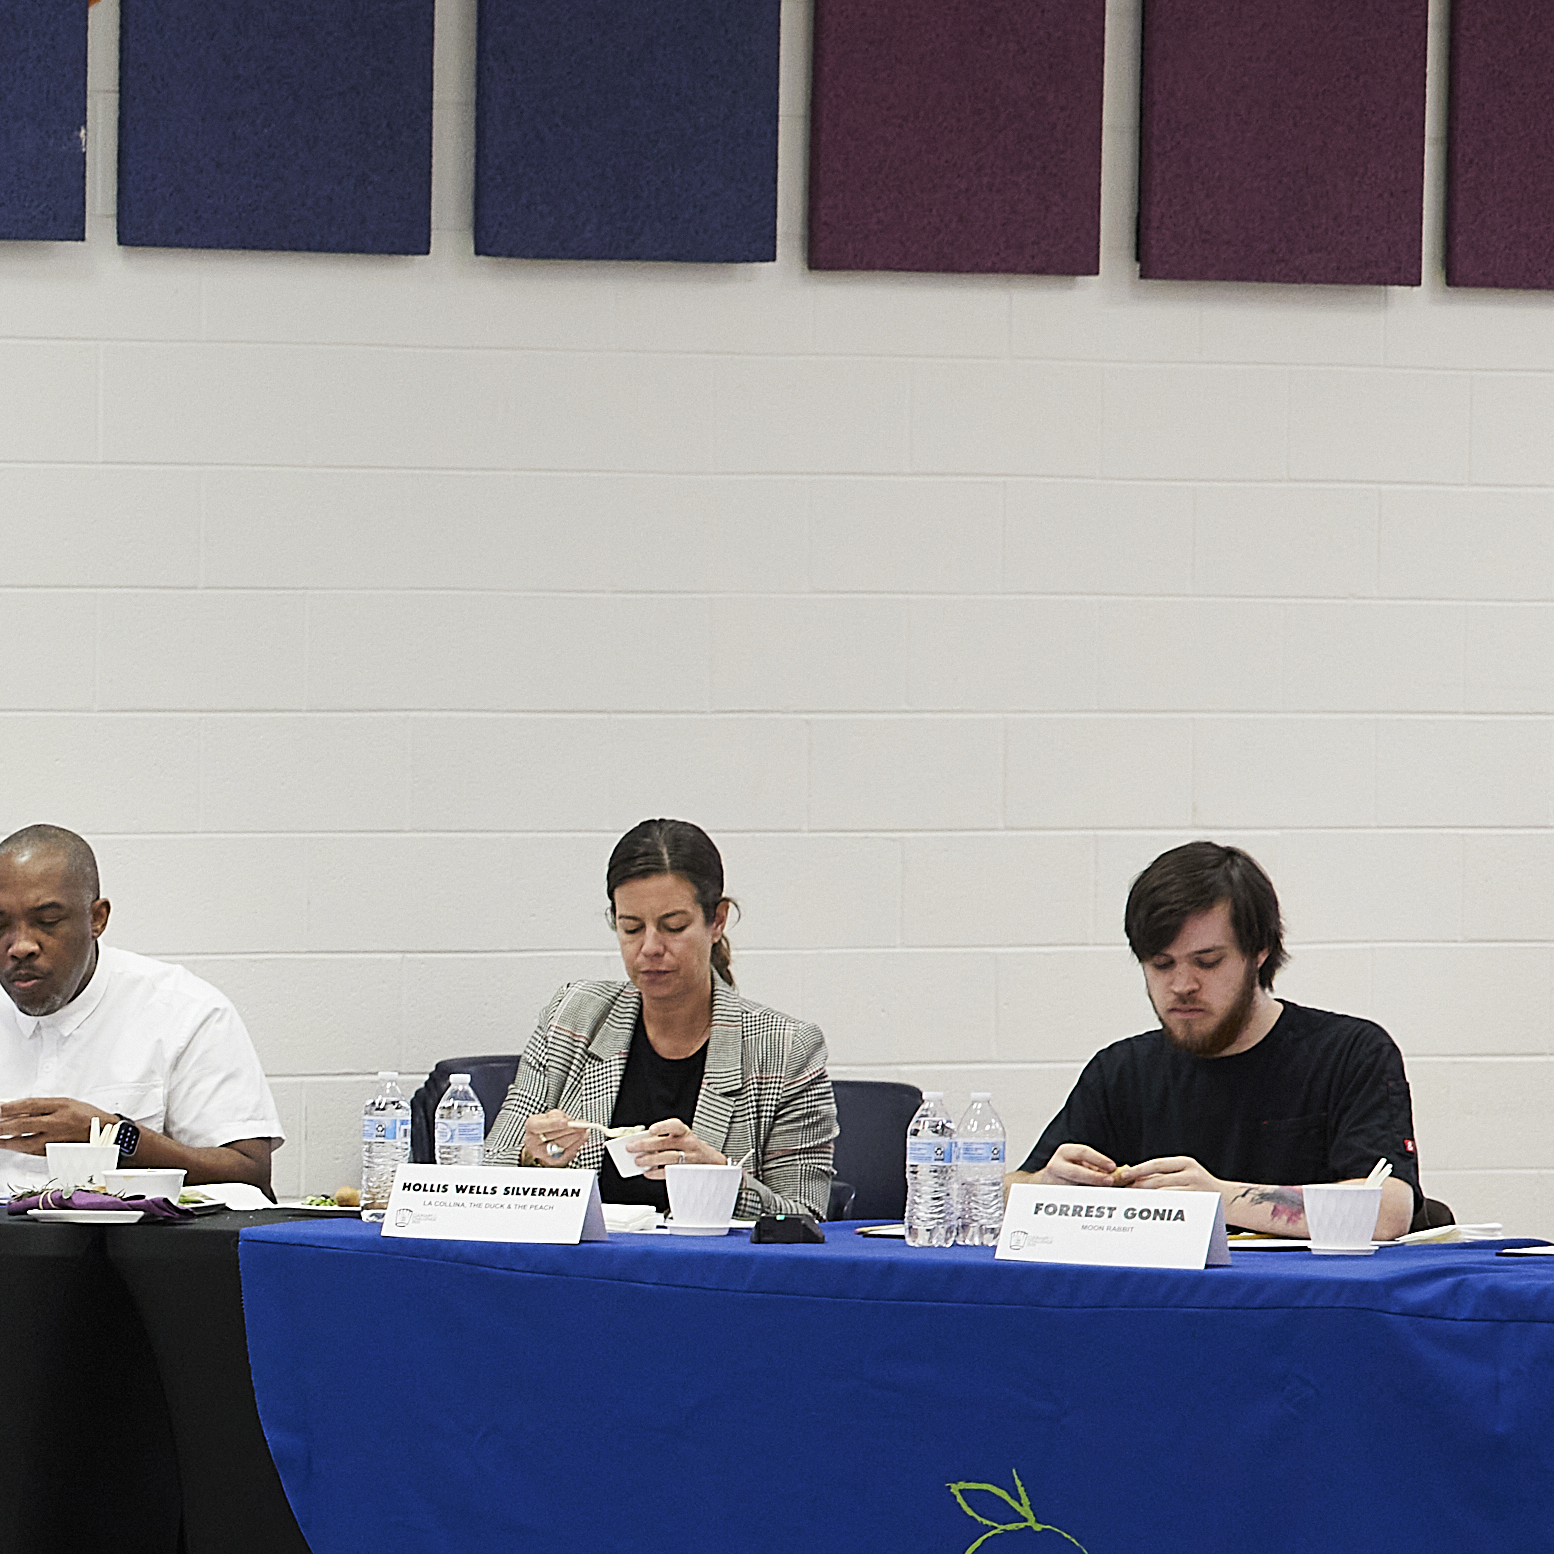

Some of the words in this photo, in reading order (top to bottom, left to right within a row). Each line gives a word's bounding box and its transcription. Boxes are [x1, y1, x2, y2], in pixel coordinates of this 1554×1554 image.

[401, 1182, 449, 1194] HOLLIS
[455, 1184, 498, 1196] WELLS
[502, 1186, 582, 1198] SILVERMAN
[484, 1202, 506, 1210] DUCK
[1033, 1202, 1118, 1219] FORREST
[1122, 1207, 1187, 1222] GONIA
[1080, 1224, 1105, 1232] MOON
[1105, 1225, 1136, 1233] RABBIT
